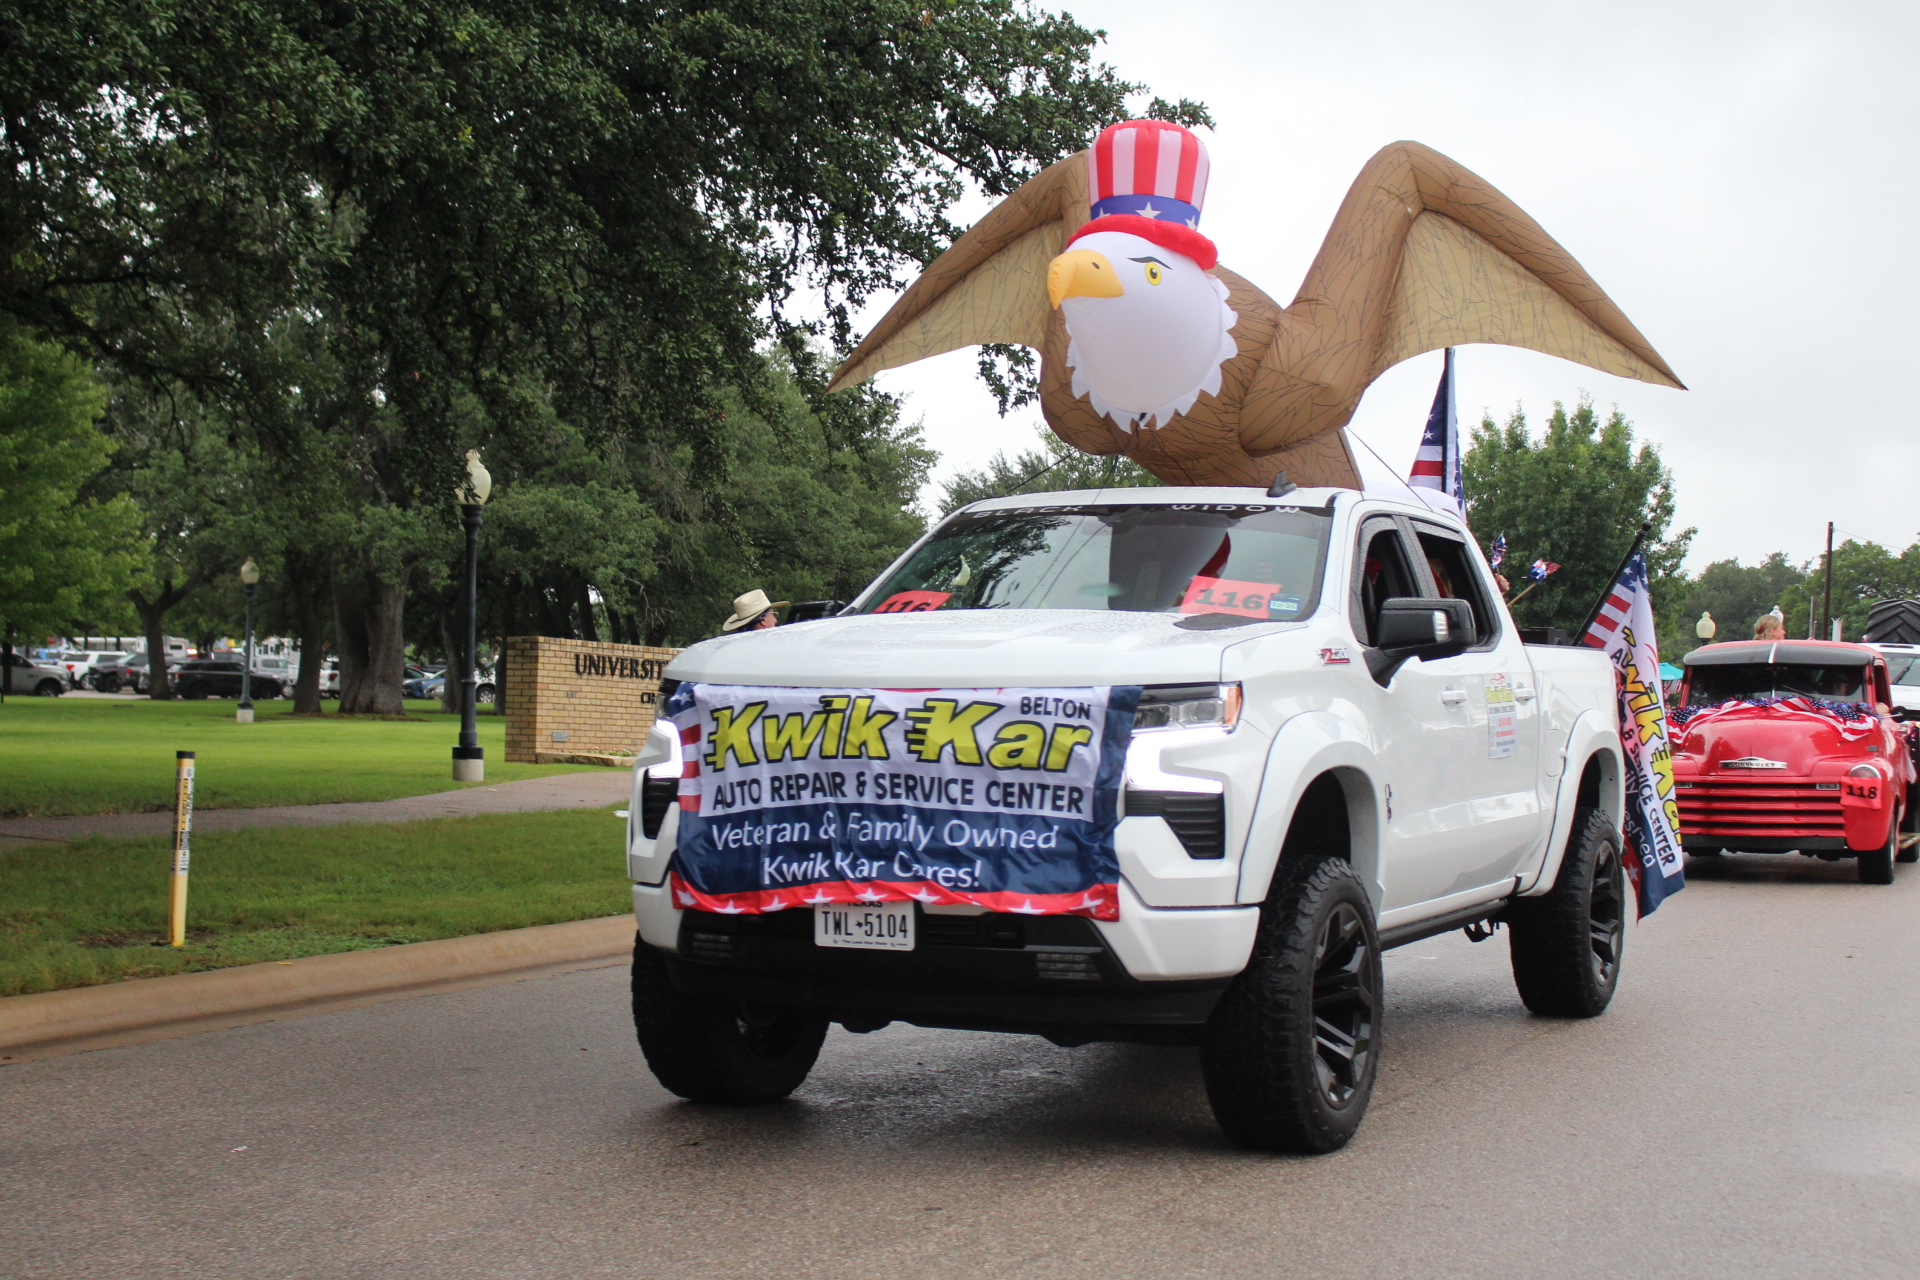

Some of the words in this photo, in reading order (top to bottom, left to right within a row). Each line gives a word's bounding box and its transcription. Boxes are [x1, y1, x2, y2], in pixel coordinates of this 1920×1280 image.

[973, 506, 1083, 518] BLACK
[1172, 504, 1299, 513] WIDOW
[1194, 588, 1265, 610] 116
[575, 654, 669, 680] UNIVERSIT
[1020, 696, 1092, 720] BELTON
[703, 695, 899, 772] Kwik
[904, 697, 1093, 772] Kar
[713, 778, 761, 810] AUTO
[770, 771, 847, 802] REPAIR
[856, 771, 867, 798] &
[873, 773, 975, 806] SERVICE
[985, 780, 1084, 814] CENTER
[1846, 785, 1877, 800] 118
[711, 820, 810, 850] Veteran
[819, 810, 836, 840] &
[847, 812, 935, 851] Family
[943, 819, 1060, 849] Owned
[1648, 807, 1675, 867] CENTER
[764, 852, 831, 885] Kwik
[835, 851, 885, 879] Kar
[821, 910, 854, 936] TWL
[864, 912, 908, 939] 5104
